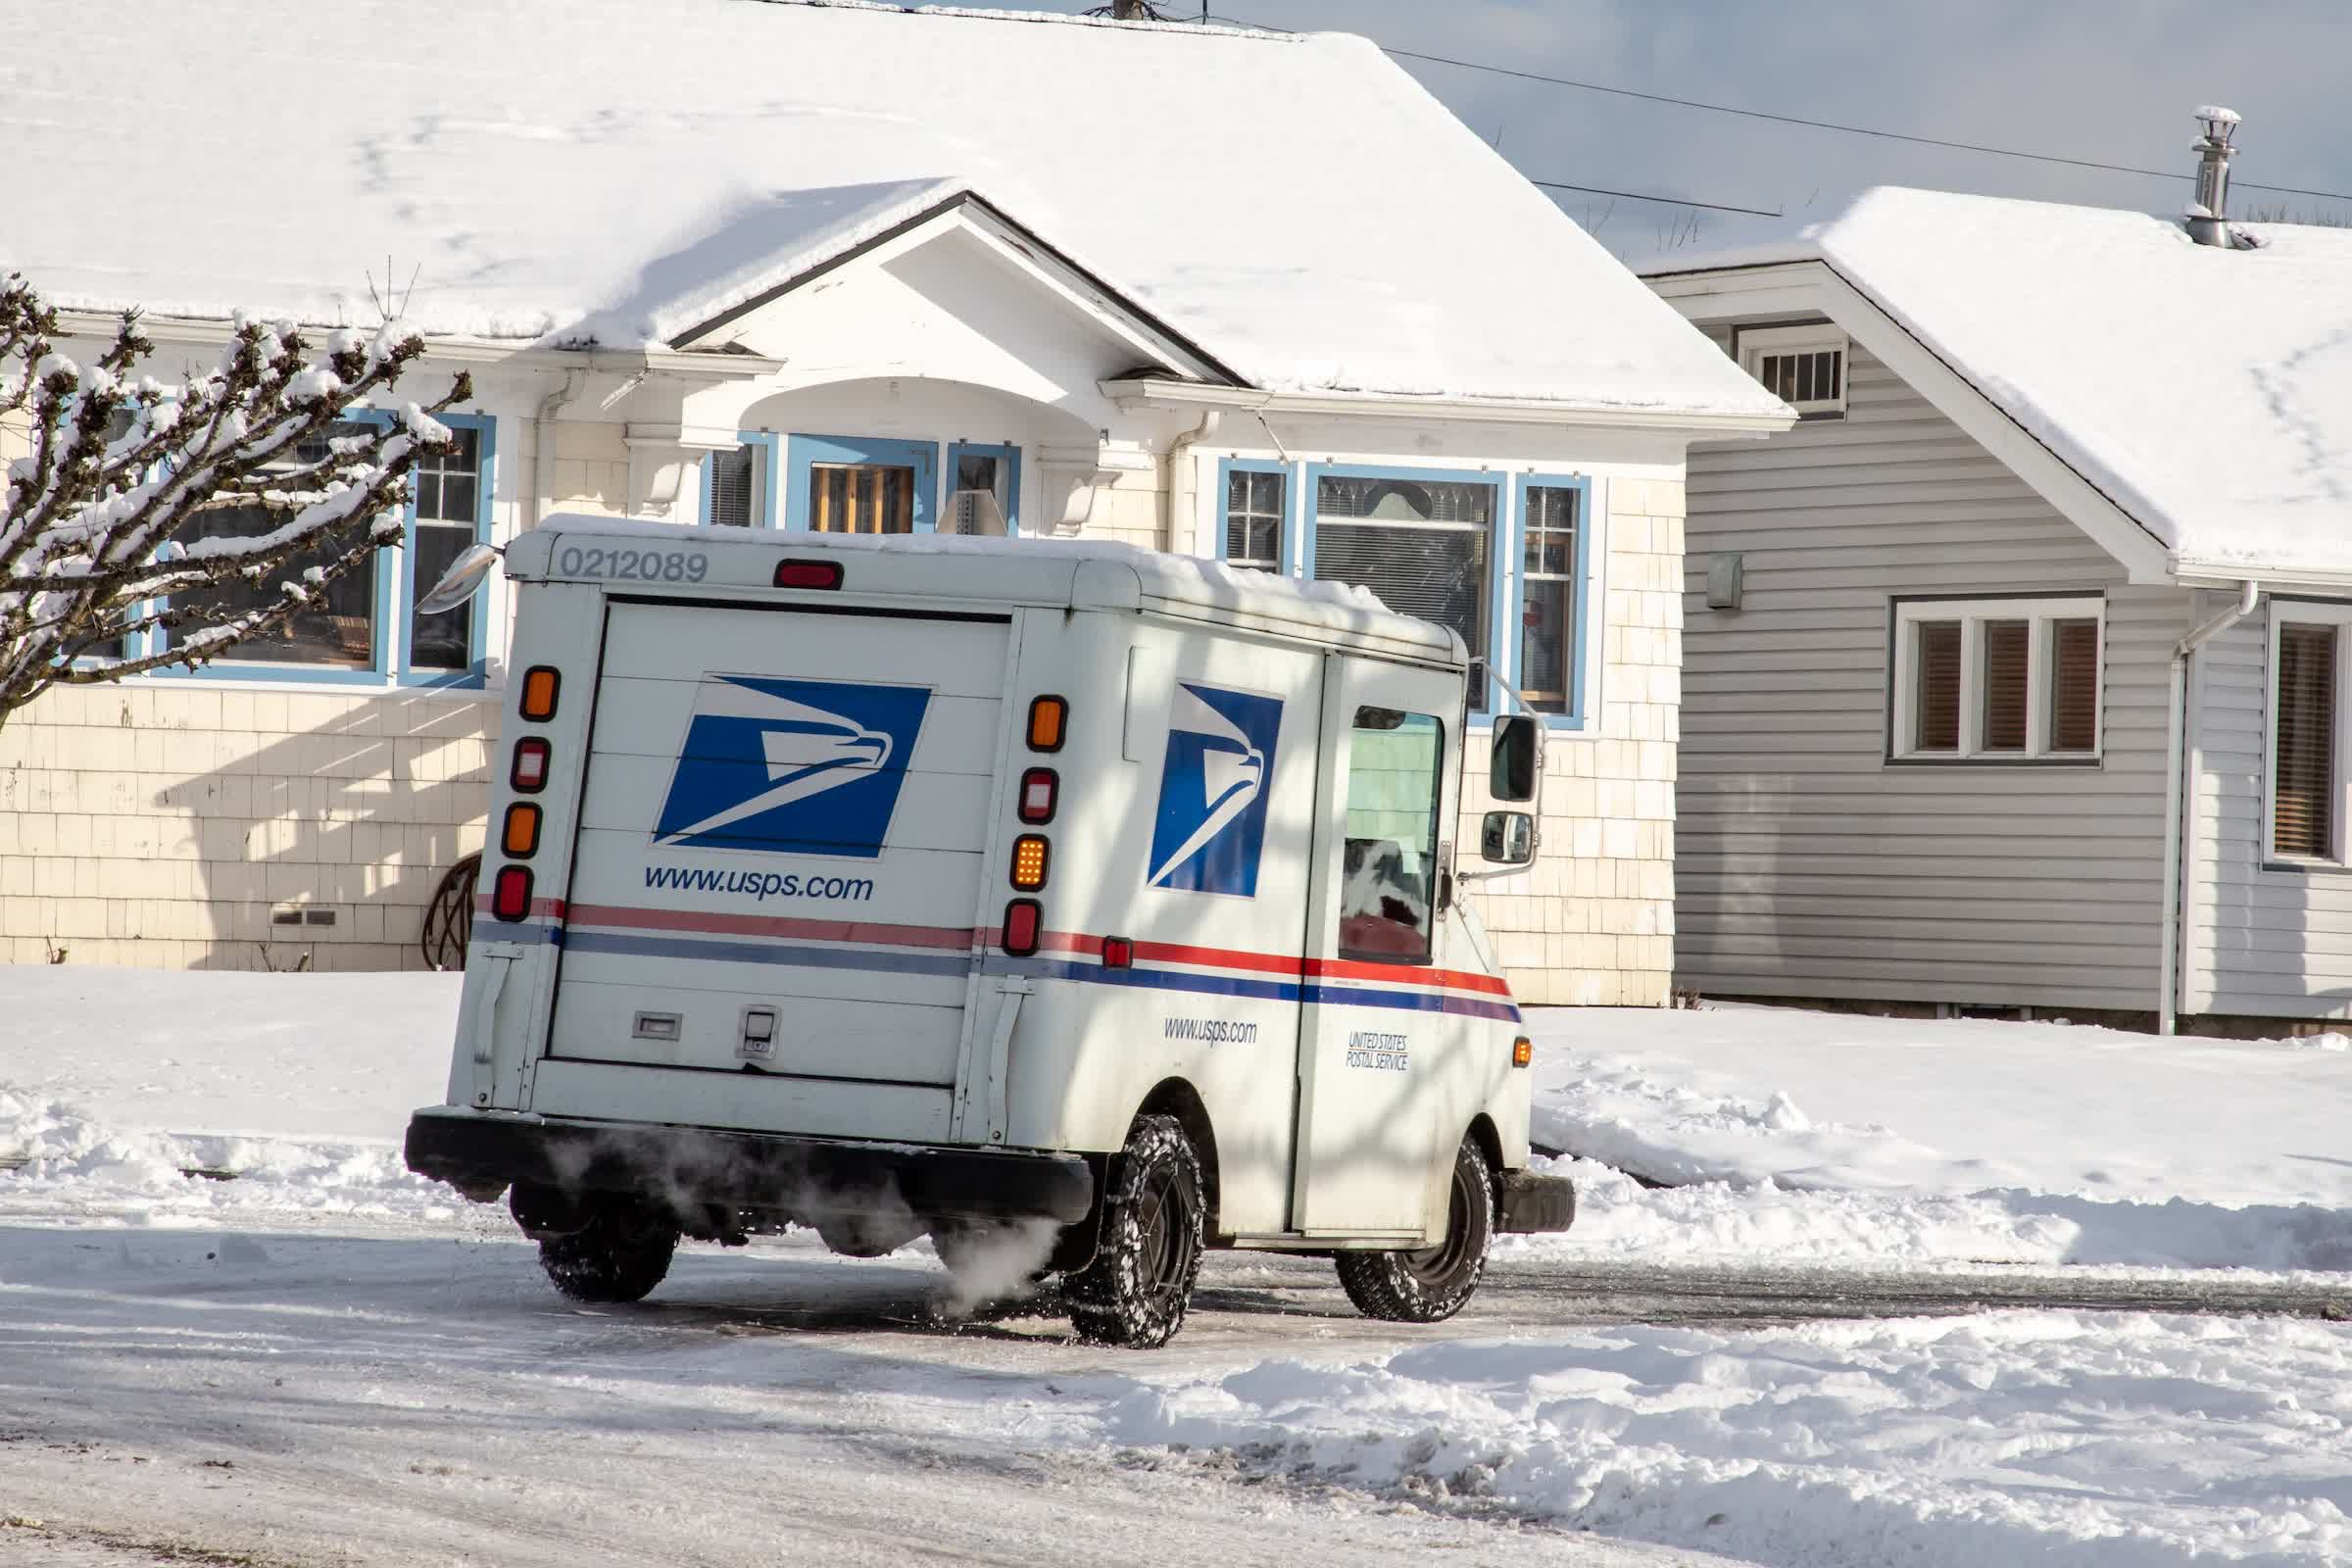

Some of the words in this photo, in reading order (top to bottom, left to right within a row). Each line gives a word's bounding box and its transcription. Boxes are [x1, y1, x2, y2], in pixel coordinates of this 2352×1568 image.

[561, 547, 708, 582] 0212089
[645, 866, 873, 902] www.usps.com
[1164, 1018, 1257, 1049] www.usps.com
[1348, 1031, 1379, 1049] UNITED
[1379, 1033, 1407, 1052] STATES
[1346, 1051, 1373, 1068] POSTAL
[1375, 1054, 1408, 1071] SERVICE
